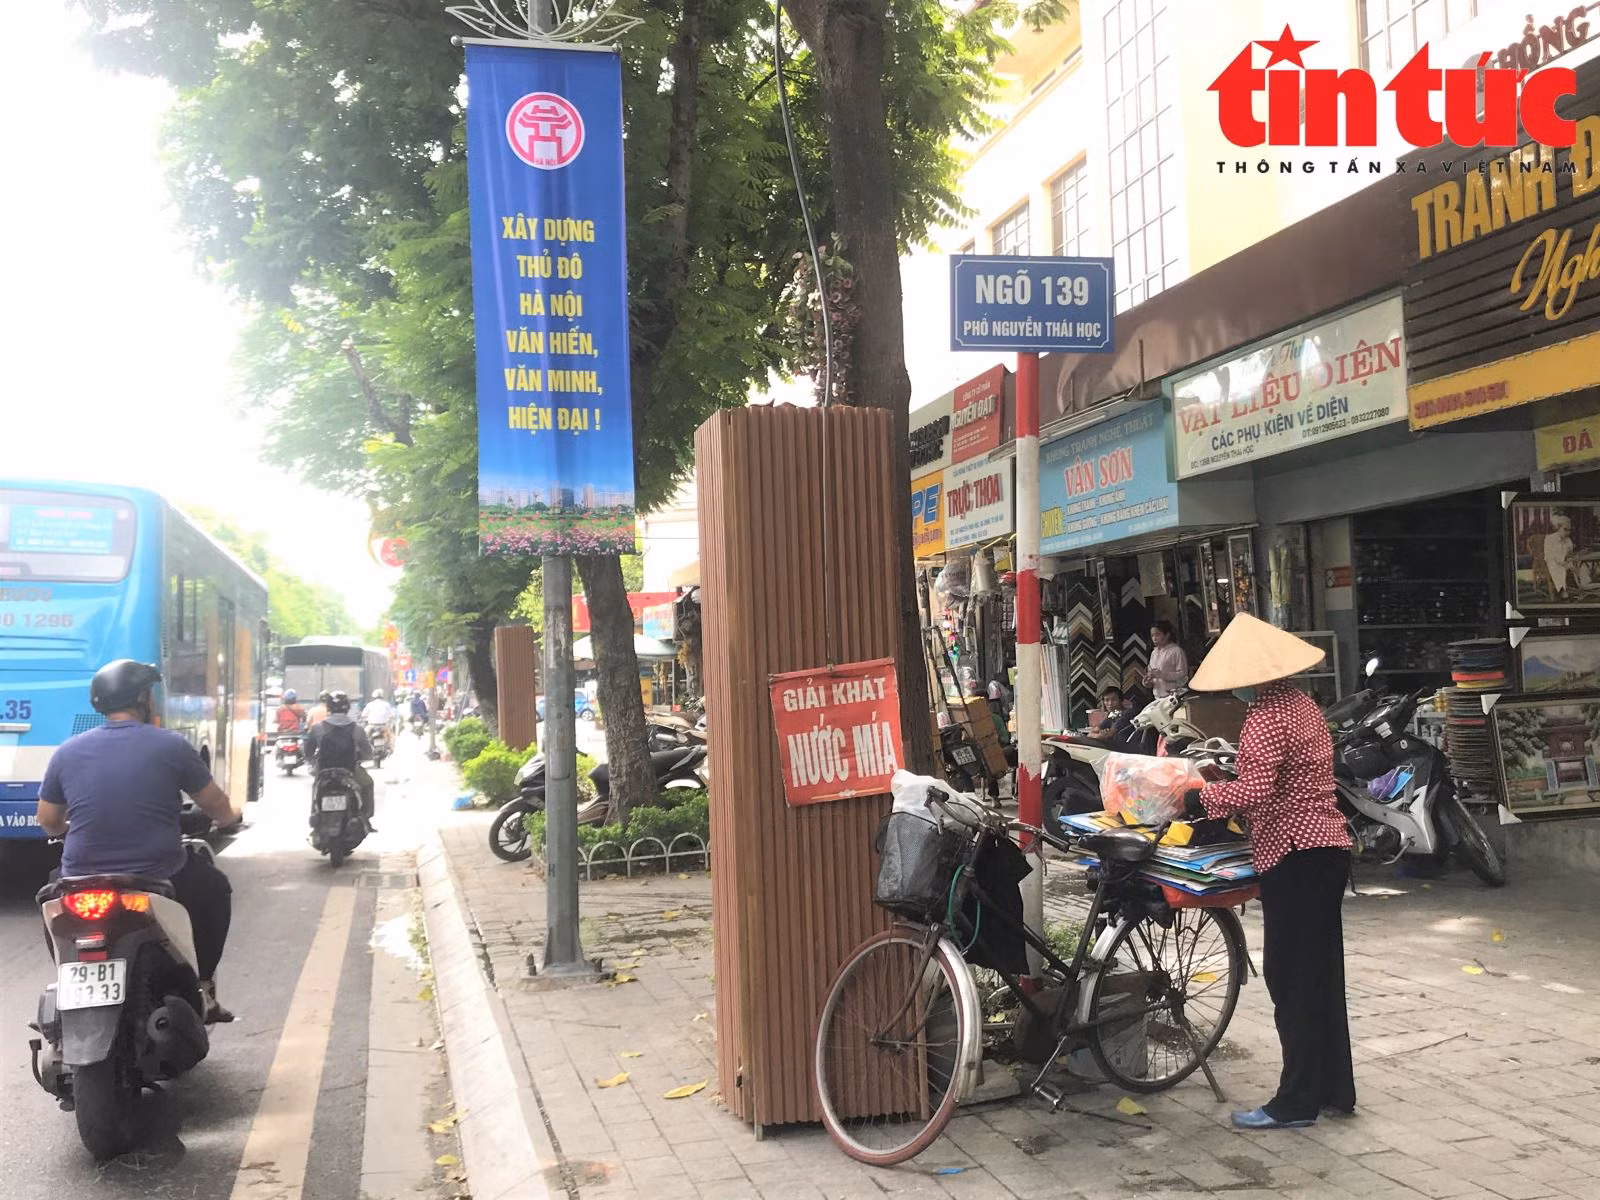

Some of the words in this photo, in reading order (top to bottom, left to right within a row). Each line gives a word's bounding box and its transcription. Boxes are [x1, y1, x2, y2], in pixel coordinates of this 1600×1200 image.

[1411, 143, 1557, 260] TRANH
[502, 213, 538, 240] XÂY
[544, 217, 595, 246] DỰNG
[517, 248, 551, 278] THỦ
[557, 252, 583, 280] ĐÔ
[975, 269, 1031, 305] NGÕ
[1041, 276, 1089, 306] 139
[519, 289, 545, 316] HÀ
[550, 290, 583, 321] NỘI
[506, 326, 544, 354] VĂN
[549, 325, 598, 358] HIẾN,
[963, 312, 988, 336] PHỐ
[992, 316, 1042, 337] NGUYỄN
[1045, 319, 1072, 337] THÁI
[1076, 322, 1101, 341] HỌC
[504, 364, 542, 392] VĂN
[547, 370, 603, 395] MINH,
[1231, 372, 1301, 415] LIỆU
[1311, 337, 1402, 391] ĐIỆN
[508, 402, 552, 434] HIỆN
[557, 407, 589, 435] ĐẠI
[1212, 429, 1234, 451] CÁC
[1237, 424, 1260, 442] PHỤ
[1264, 413, 1294, 436] KIỆN
[1316, 396, 1348, 420] ĐIỆN
[1064, 456, 1095, 498] VÂN
[1098, 446, 1133, 488] SƠN
[783, 677, 826, 712] GIẢI
[832, 675, 886, 705] KHÁT
[787, 713, 849, 788] NƯỚC
[852, 711, 898, 778] MÍA
[6, 811, 26, 827] VÀO
[70, 963, 115, 983] 29-B1
